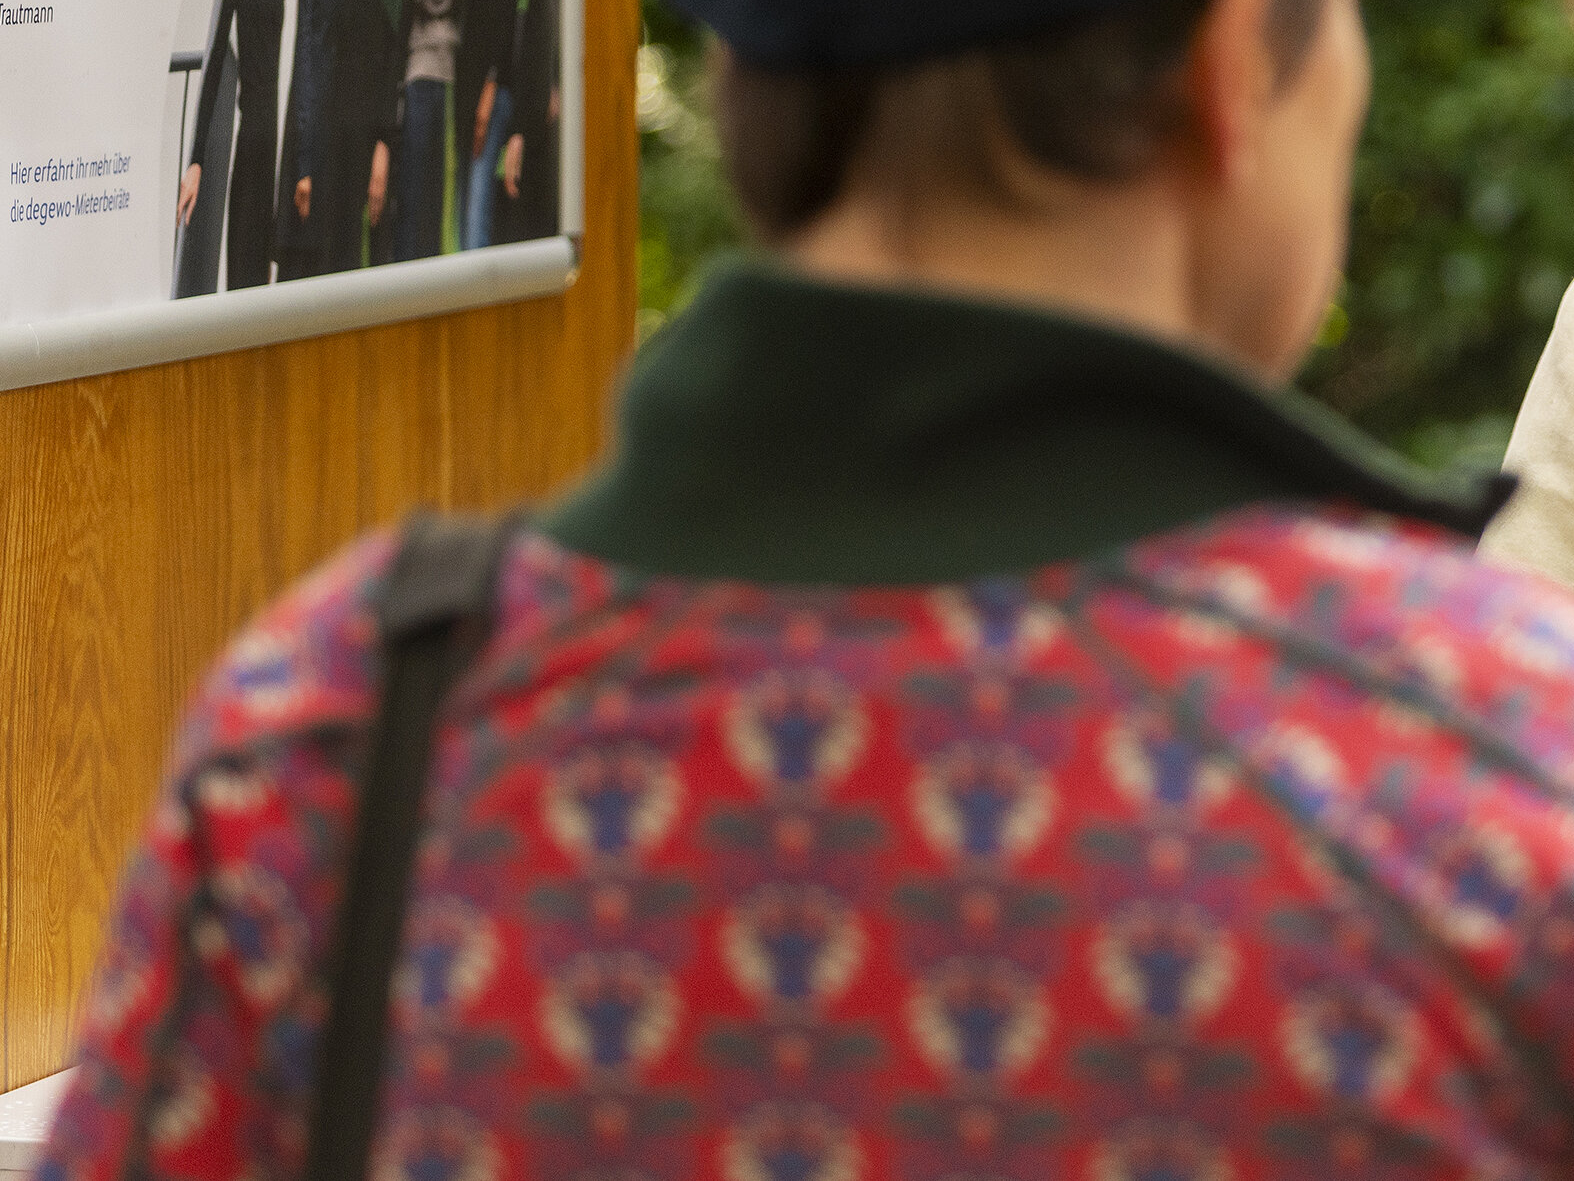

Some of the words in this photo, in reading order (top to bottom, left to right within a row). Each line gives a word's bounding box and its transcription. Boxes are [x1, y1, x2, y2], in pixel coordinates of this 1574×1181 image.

[10, 161, 32, 184] Hier
[34, 158, 74, 182] erfahrt
[75, 156, 89, 179] ihr
[89, 154, 112, 178] mehr
[113, 152, 131, 175] über
[10, 199, 24, 222] die
[26, 188, 130, 225] degewo-Mieterbeiräte
